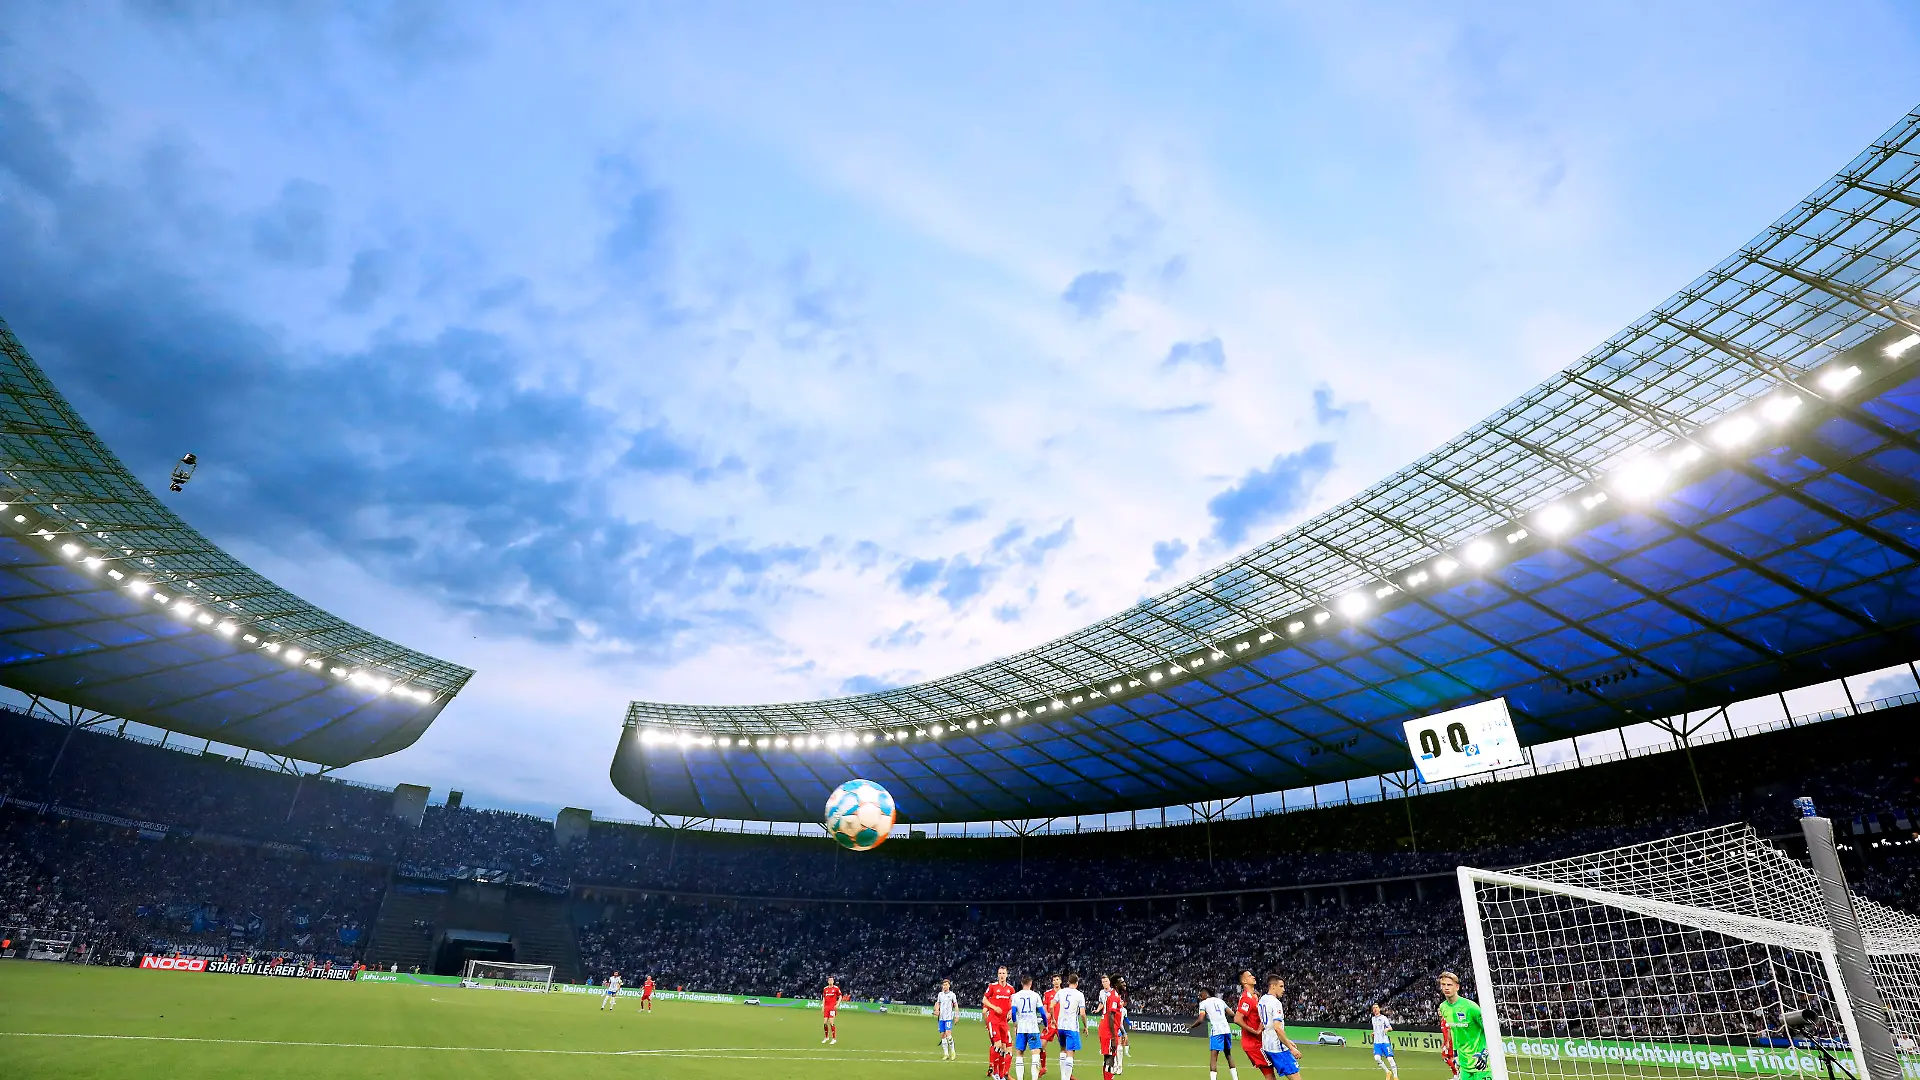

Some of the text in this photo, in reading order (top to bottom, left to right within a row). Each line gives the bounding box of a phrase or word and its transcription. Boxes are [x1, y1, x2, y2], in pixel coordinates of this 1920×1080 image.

[1419, 728, 1442, 759] 0
[1446, 722, 1470, 753] 0
[143, 957, 205, 972] NOCO
[296, 967, 350, 979] BTTRIEN
[563, 984, 587, 994] Deine
[1020, 997, 1034, 1014] 21
[1064, 994, 1072, 1010] 5
[1213, 1002, 1222, 1016] 4
[1398, 1033, 1418, 1048] wir
[1422, 1034, 1443, 1049] sin
[1521, 1042, 1559, 1060] easy
